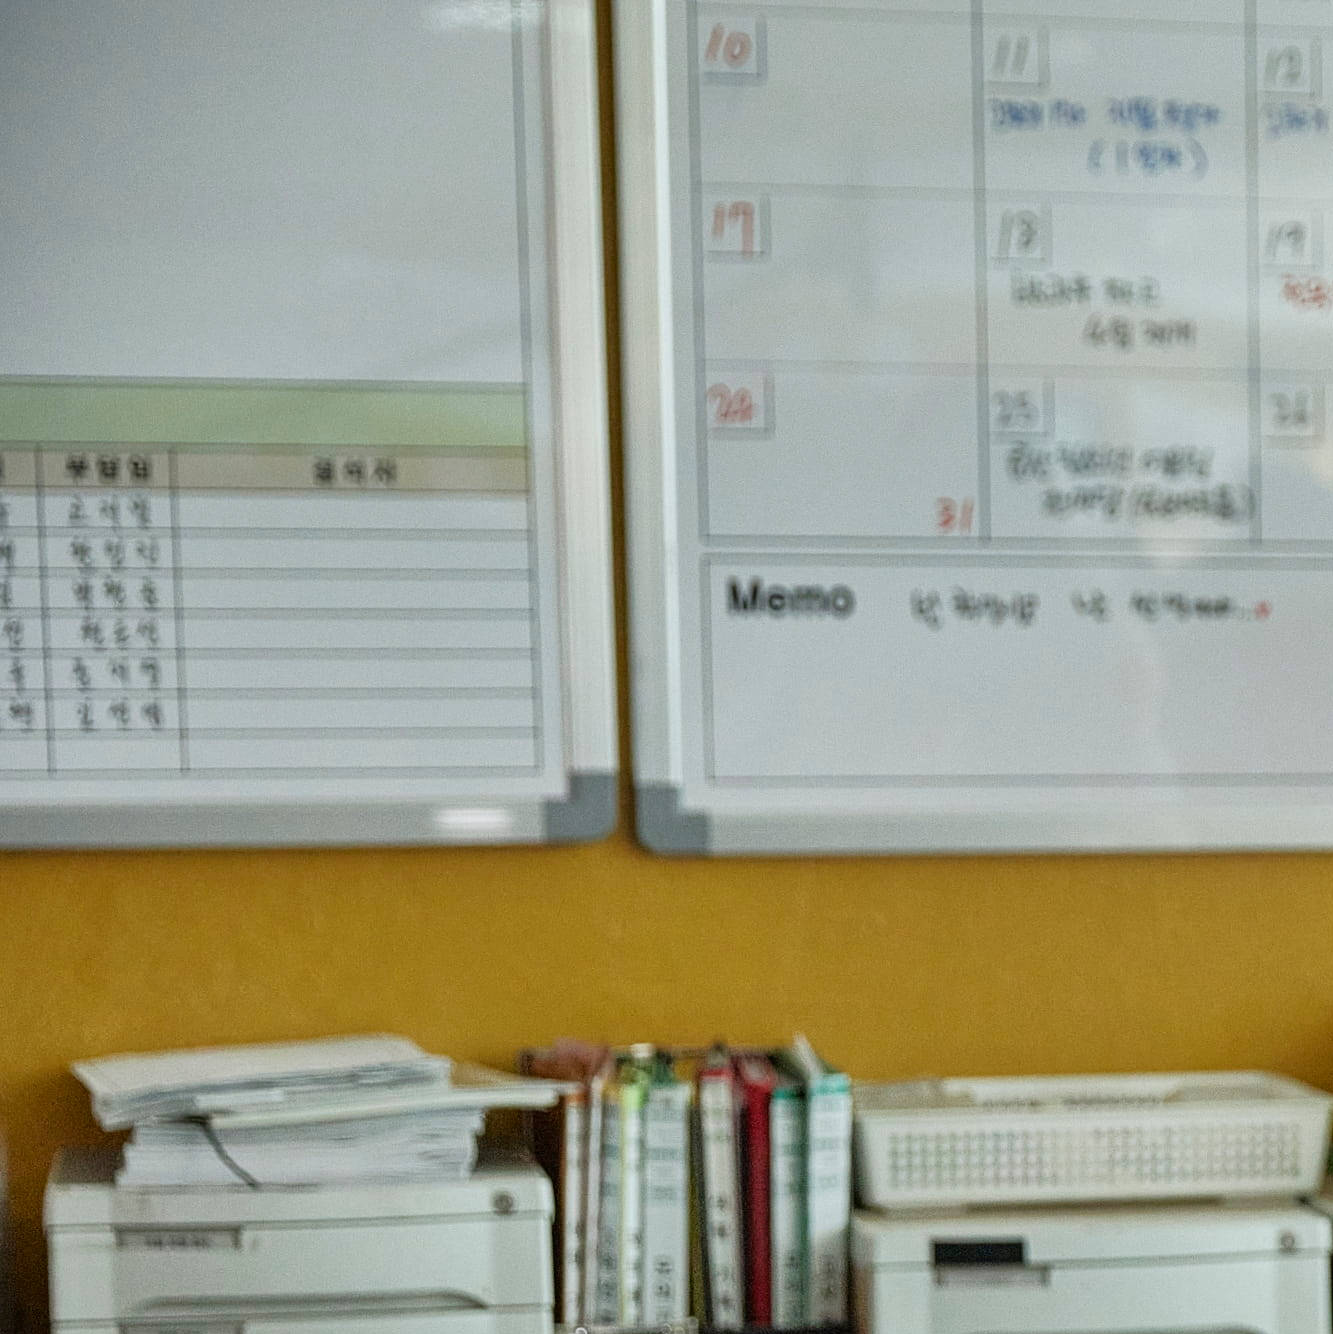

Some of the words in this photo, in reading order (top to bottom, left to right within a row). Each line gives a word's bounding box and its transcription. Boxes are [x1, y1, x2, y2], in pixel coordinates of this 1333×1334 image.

[704, 22, 753, 68] 10
[997, 33, 1031, 75] 11
[711, 201, 755, 260] 17
[726, 575, 857, 618] Memo
